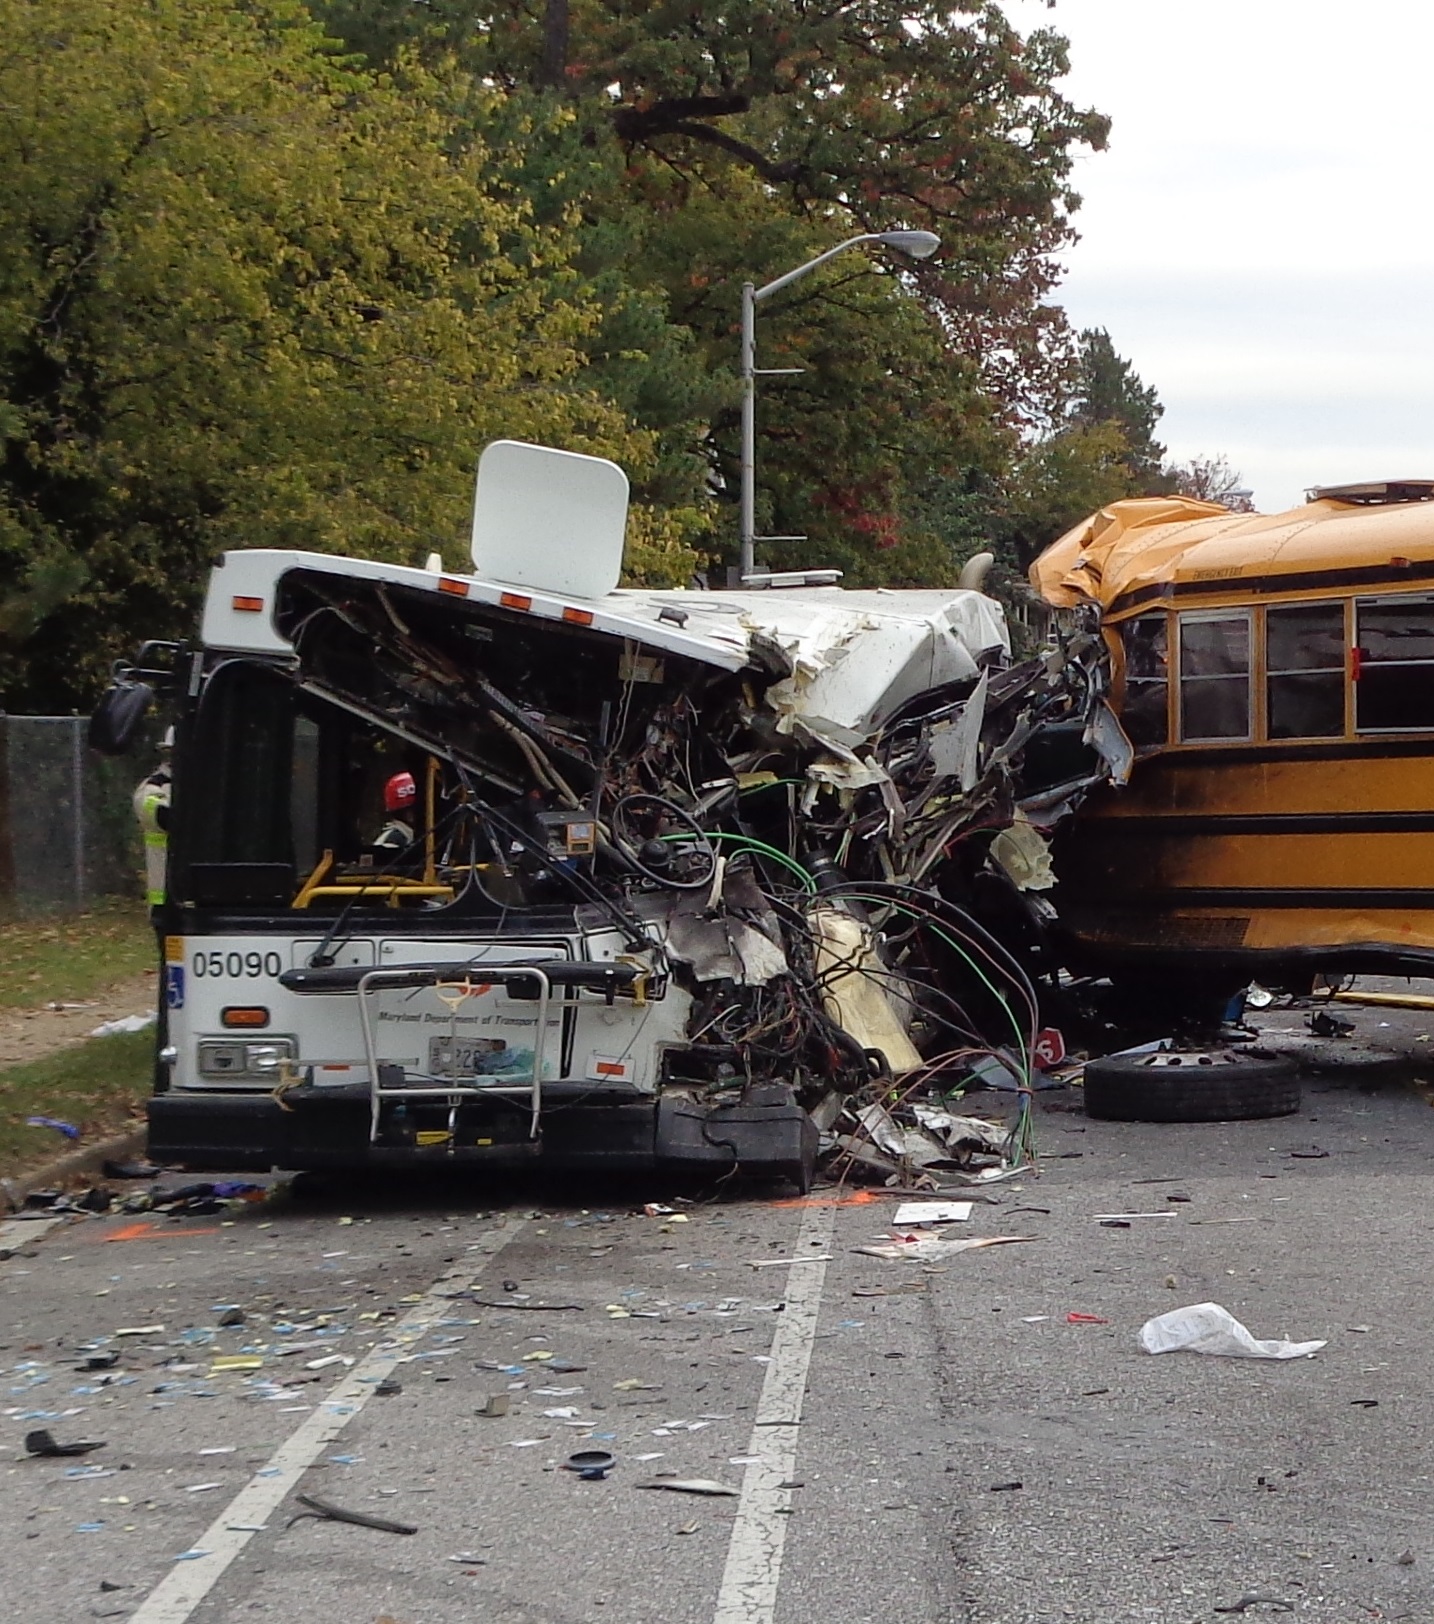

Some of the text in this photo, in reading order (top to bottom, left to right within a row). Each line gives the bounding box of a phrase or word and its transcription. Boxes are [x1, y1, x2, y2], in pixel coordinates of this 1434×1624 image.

[192, 951, 282, 978] 05090
[379, 1011, 421, 1023] Maryland
[424, 1013, 478, 1024] Deparment
[481, 1015, 493, 1025] of
